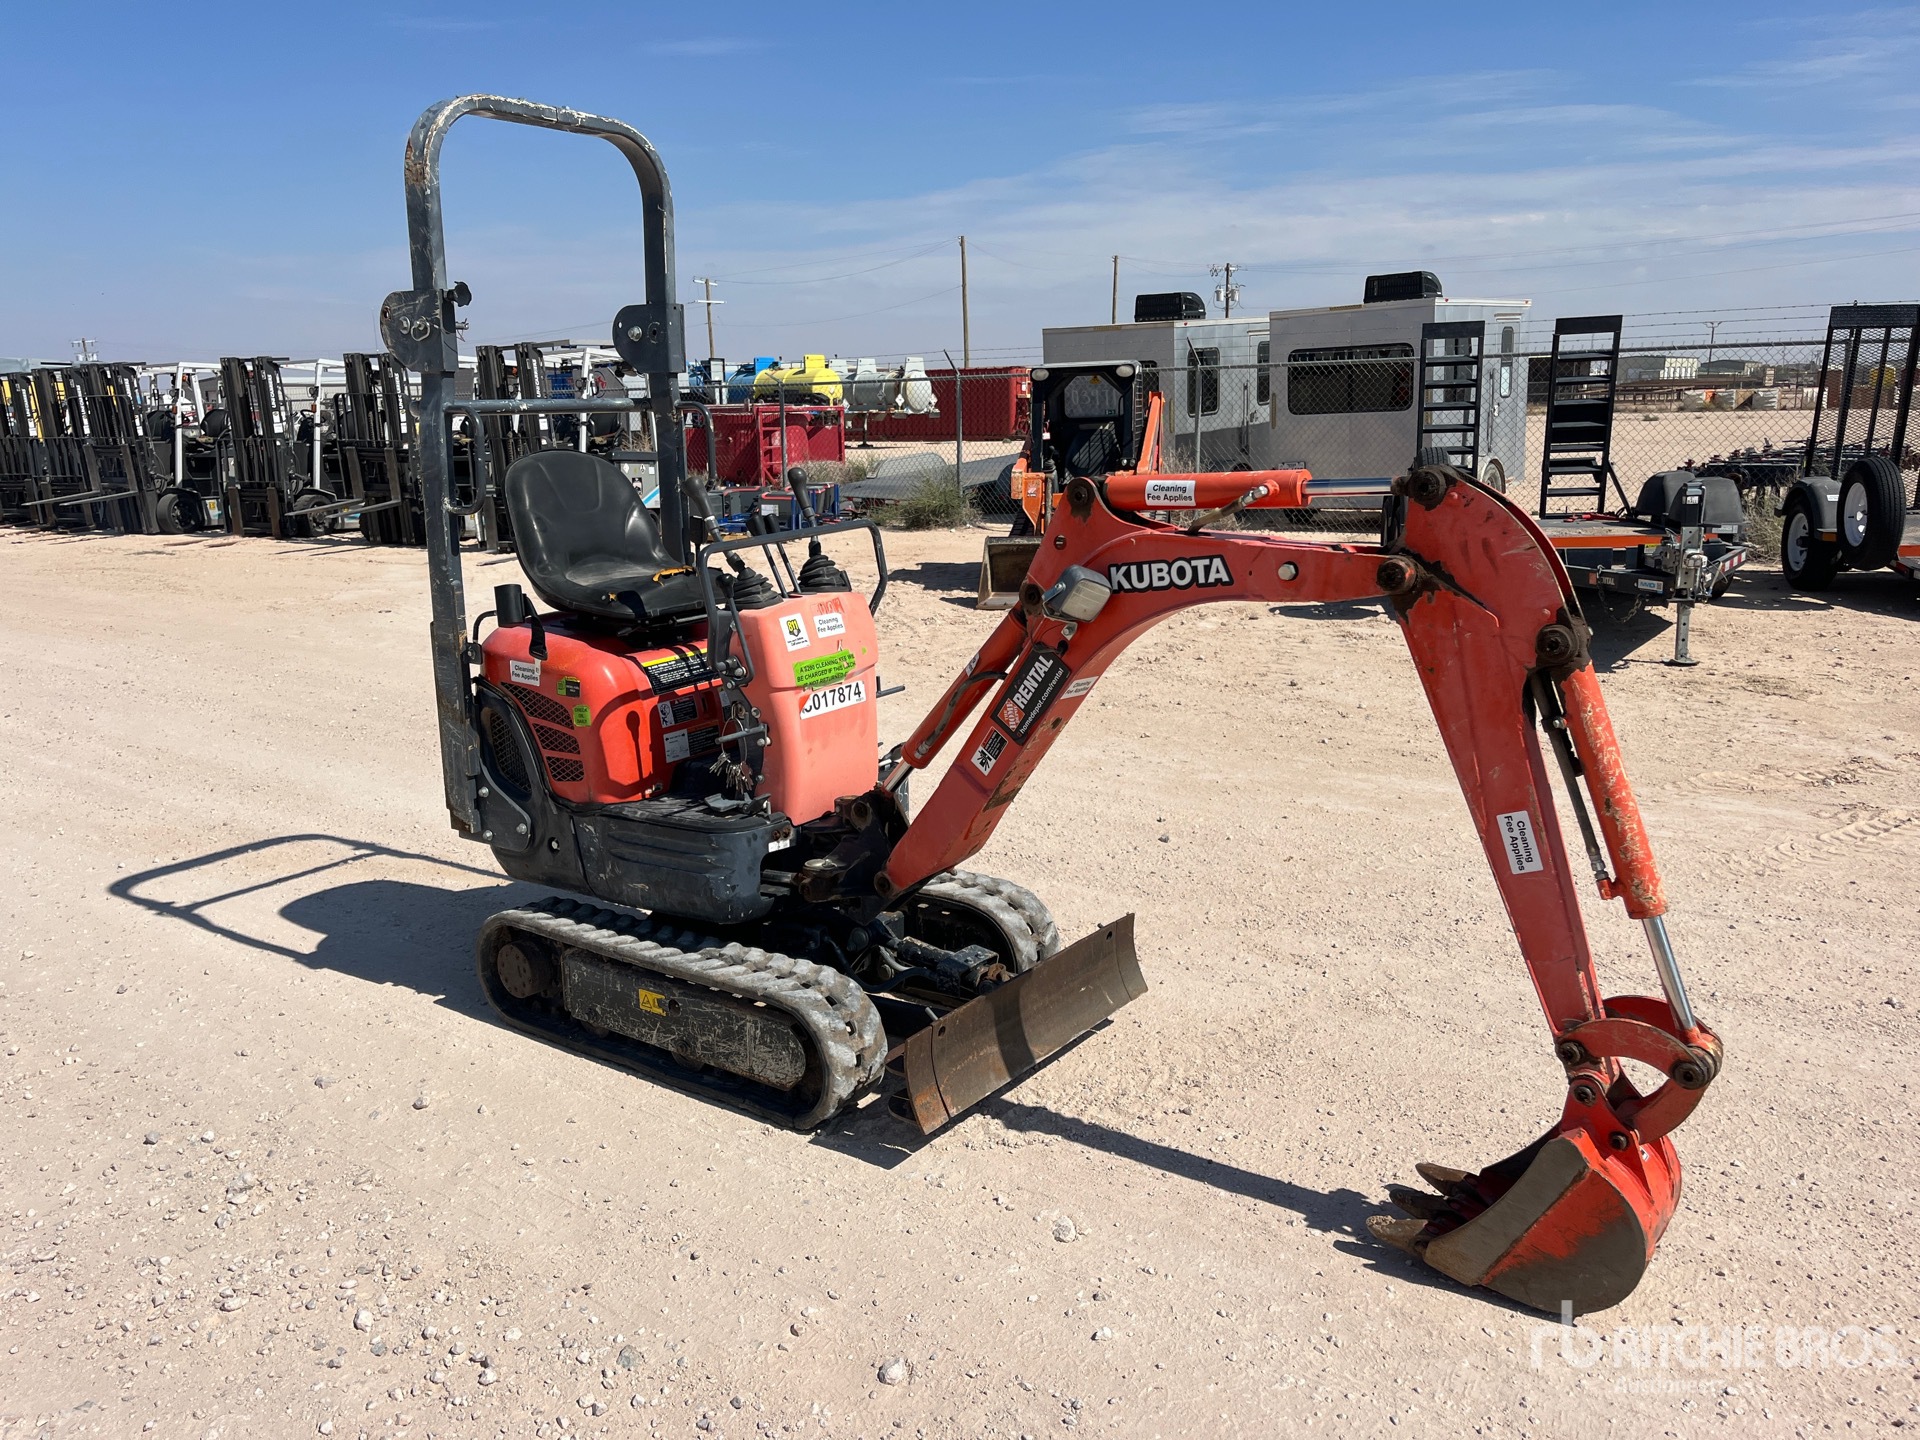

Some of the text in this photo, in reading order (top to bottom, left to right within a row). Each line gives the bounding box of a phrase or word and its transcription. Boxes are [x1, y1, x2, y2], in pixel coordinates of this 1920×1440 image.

[1152, 484, 1187, 494] Cleaning
[1163, 493, 1193, 502] Applies
[1110, 557, 1230, 591] KUBOTA
[786, 619, 798, 632] 811
[818, 617, 839, 625] Cleaning
[827, 623, 844, 632] Applies
[815, 659, 839, 668] CLEANING
[514, 665, 535, 675] Cleaning
[521, 673, 539, 681] Applies
[805, 670, 828, 681] CHARGED
[1012, 655, 1054, 710] RENTAL
[1020, 667, 1064, 734] homedepot.com/rental
[1504, 815, 1525, 871] Fee Applies
[1517, 821, 1534, 863] Cleaning
